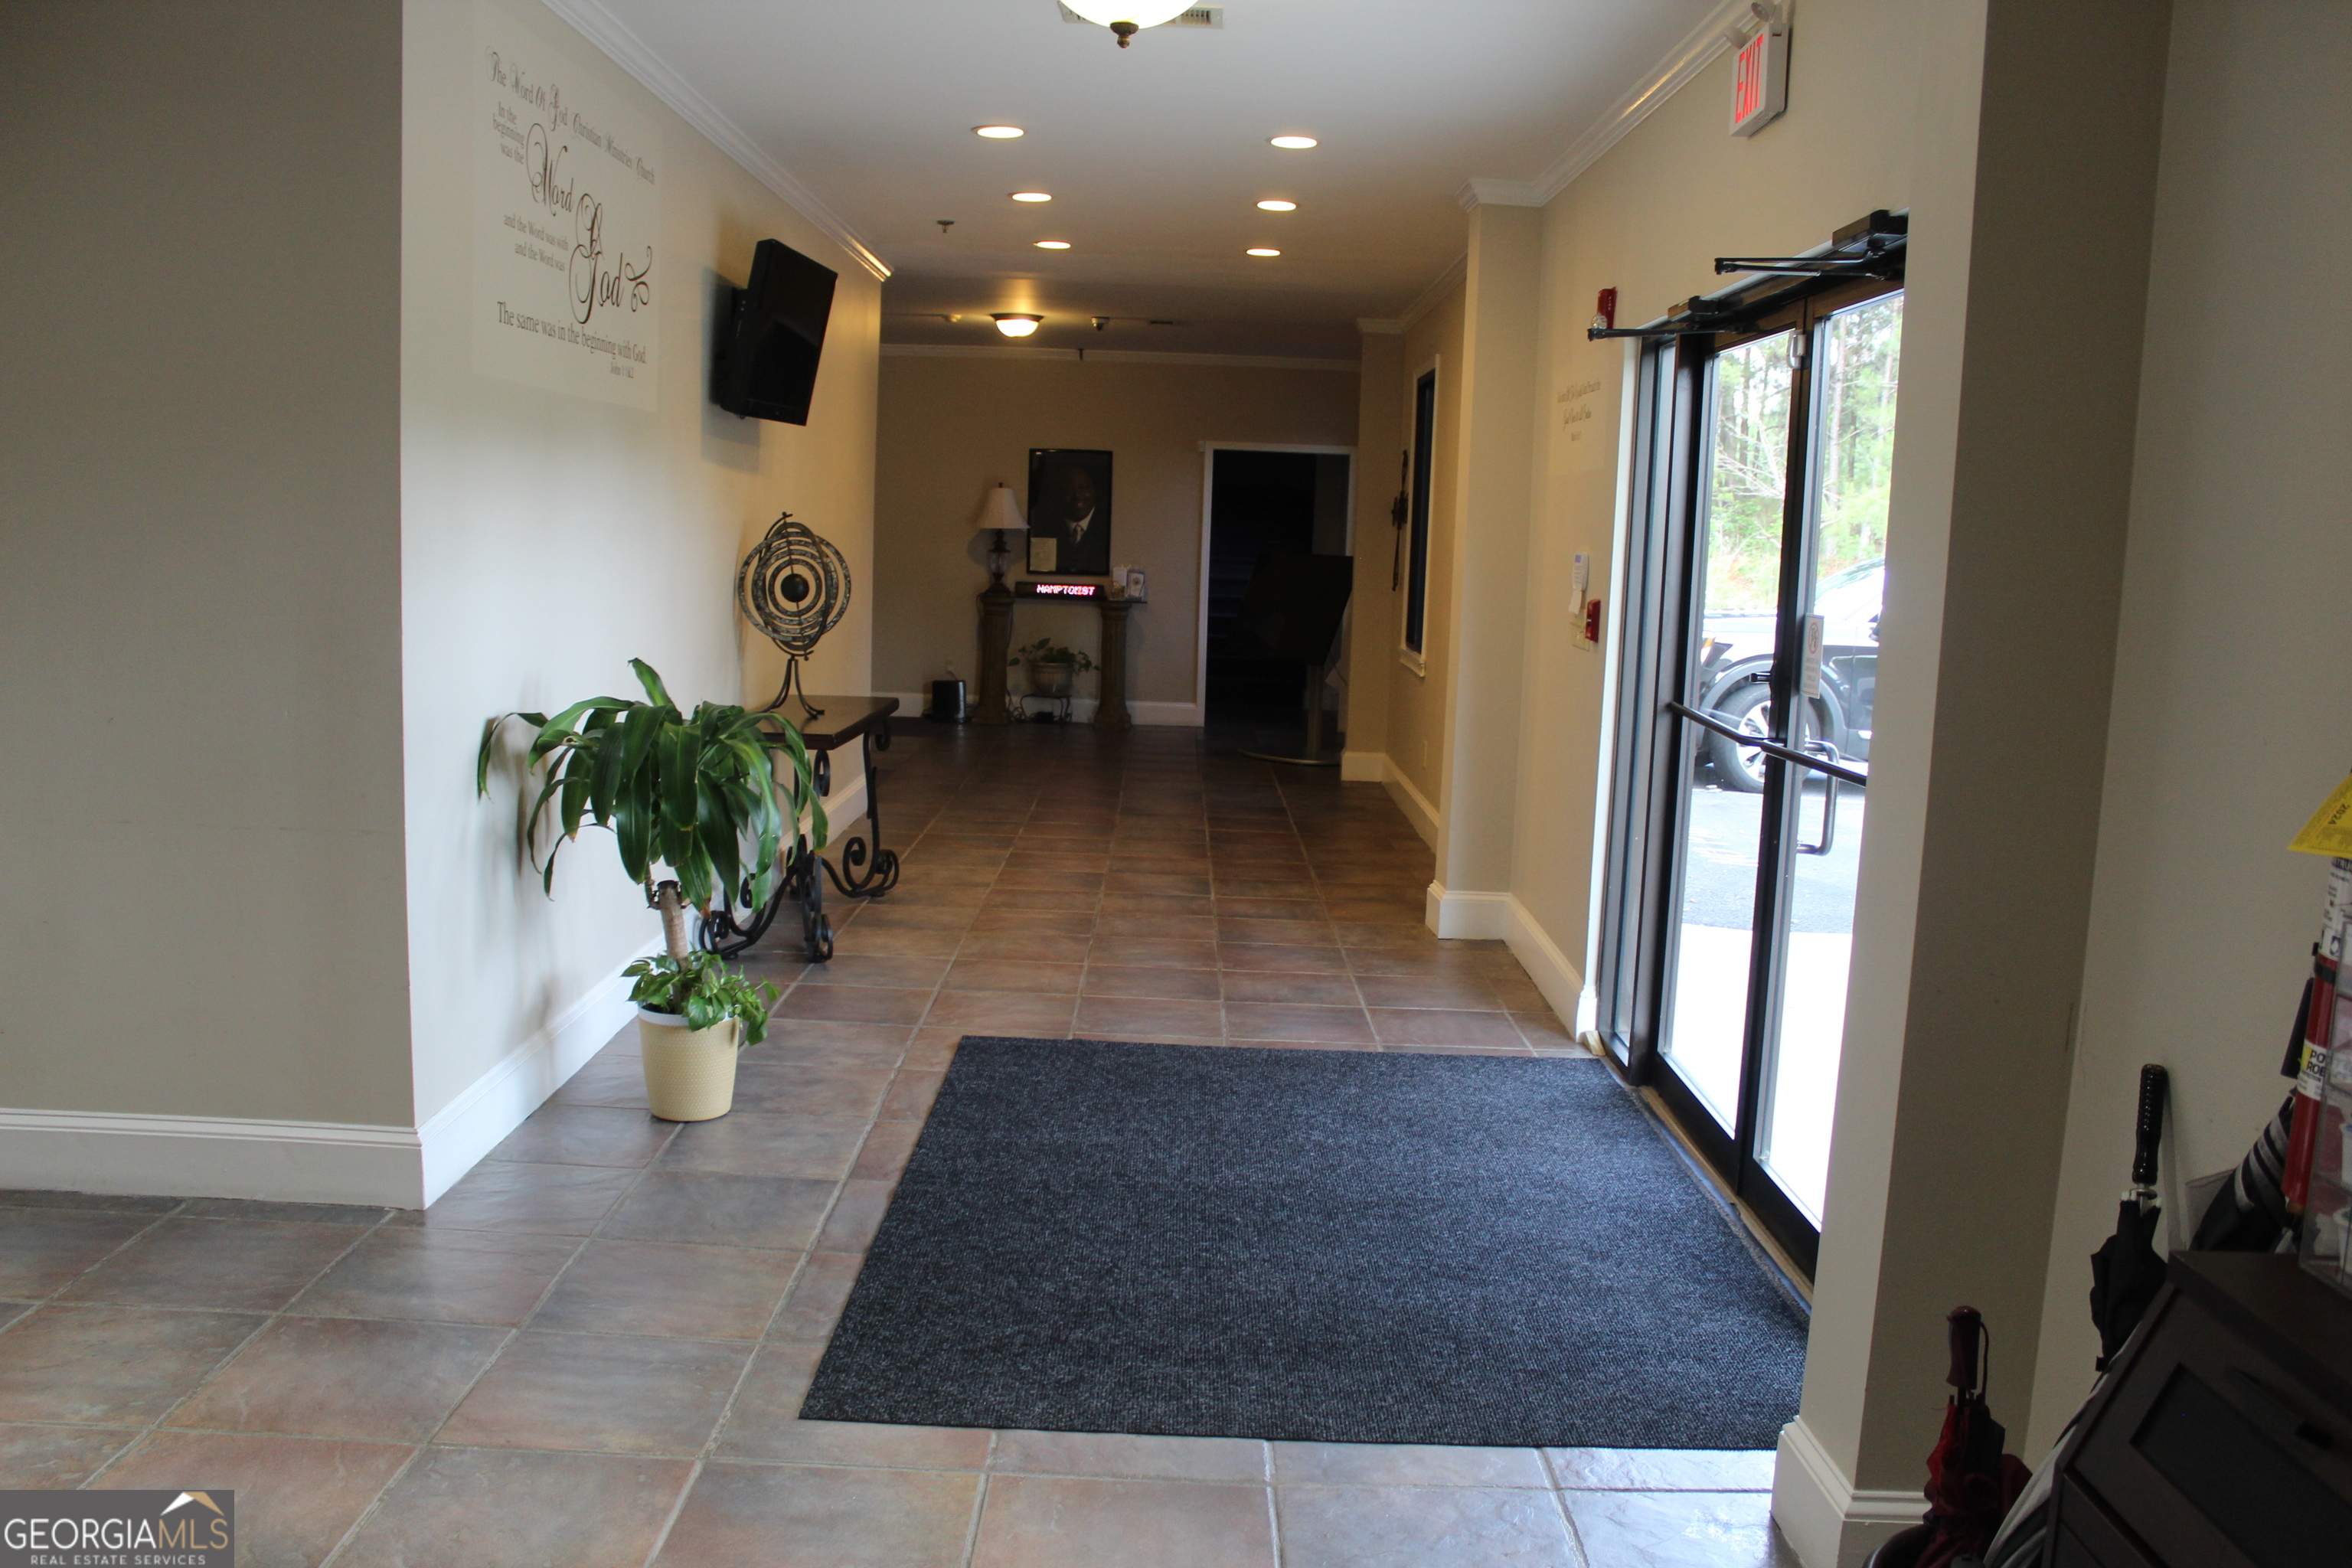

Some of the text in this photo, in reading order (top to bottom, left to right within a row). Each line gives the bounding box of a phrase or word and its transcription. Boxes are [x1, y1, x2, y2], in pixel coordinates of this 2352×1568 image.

[1735, 34, 1764, 124] EXIT
[485, 46, 506, 87] The
[548, 83, 567, 132] God
[572, 113, 602, 148] Christian
[605, 131, 632, 169] Ministries
[492, 112, 524, 149] beginning
[507, 106, 517, 125] the
[500, 143, 524, 165] was the
[526, 122, 573, 217] Word
[504, 214, 569, 251] and the Word was with
[514, 242, 565, 272] and the Word was
[569, 193, 624, 325] God
[498, 301, 514, 326] The
[516, 312, 540, 333] same
[541, 320, 557, 338] was
[557, 320, 566, 341] in
[568, 322, 580, 345] the
[581, 326, 616, 360] beginning
[618, 340, 632, 360] with
